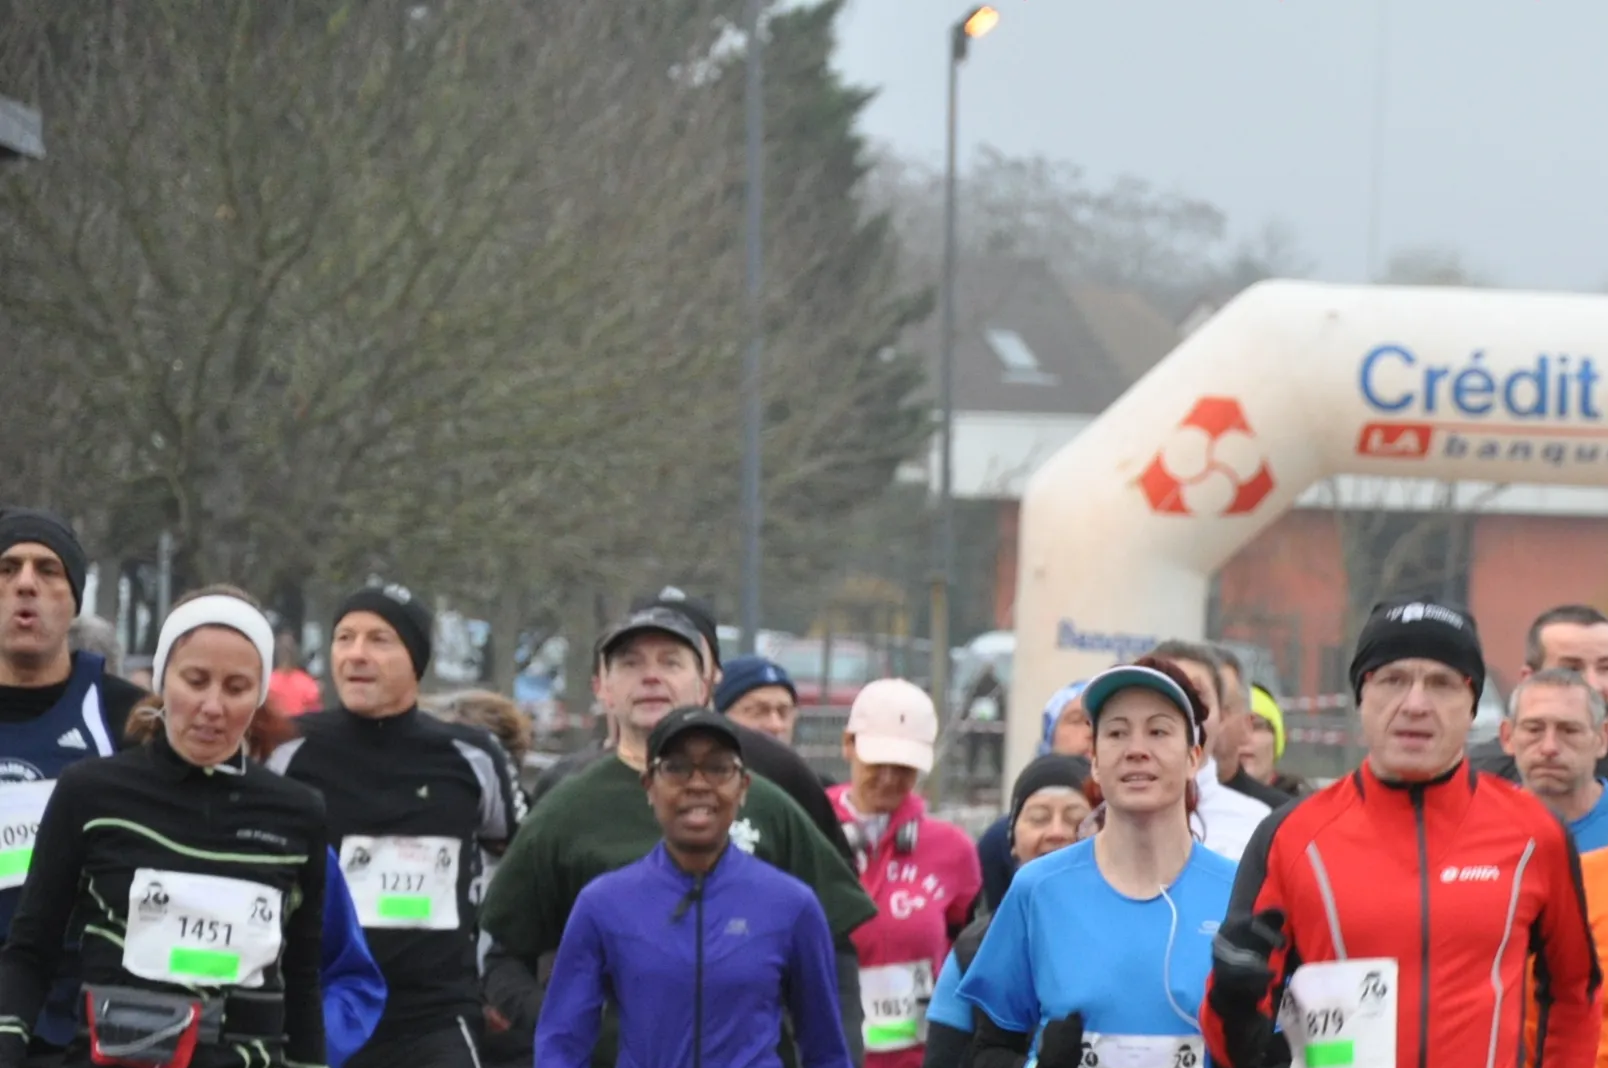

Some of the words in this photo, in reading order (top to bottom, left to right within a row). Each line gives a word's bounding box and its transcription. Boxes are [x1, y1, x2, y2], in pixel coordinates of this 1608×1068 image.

[1359, 343, 1602, 420] Crédit
[1366, 428, 1421, 453] LA
[178, 915, 233, 946] 1451
[1306, 1007, 1344, 1037] 879
